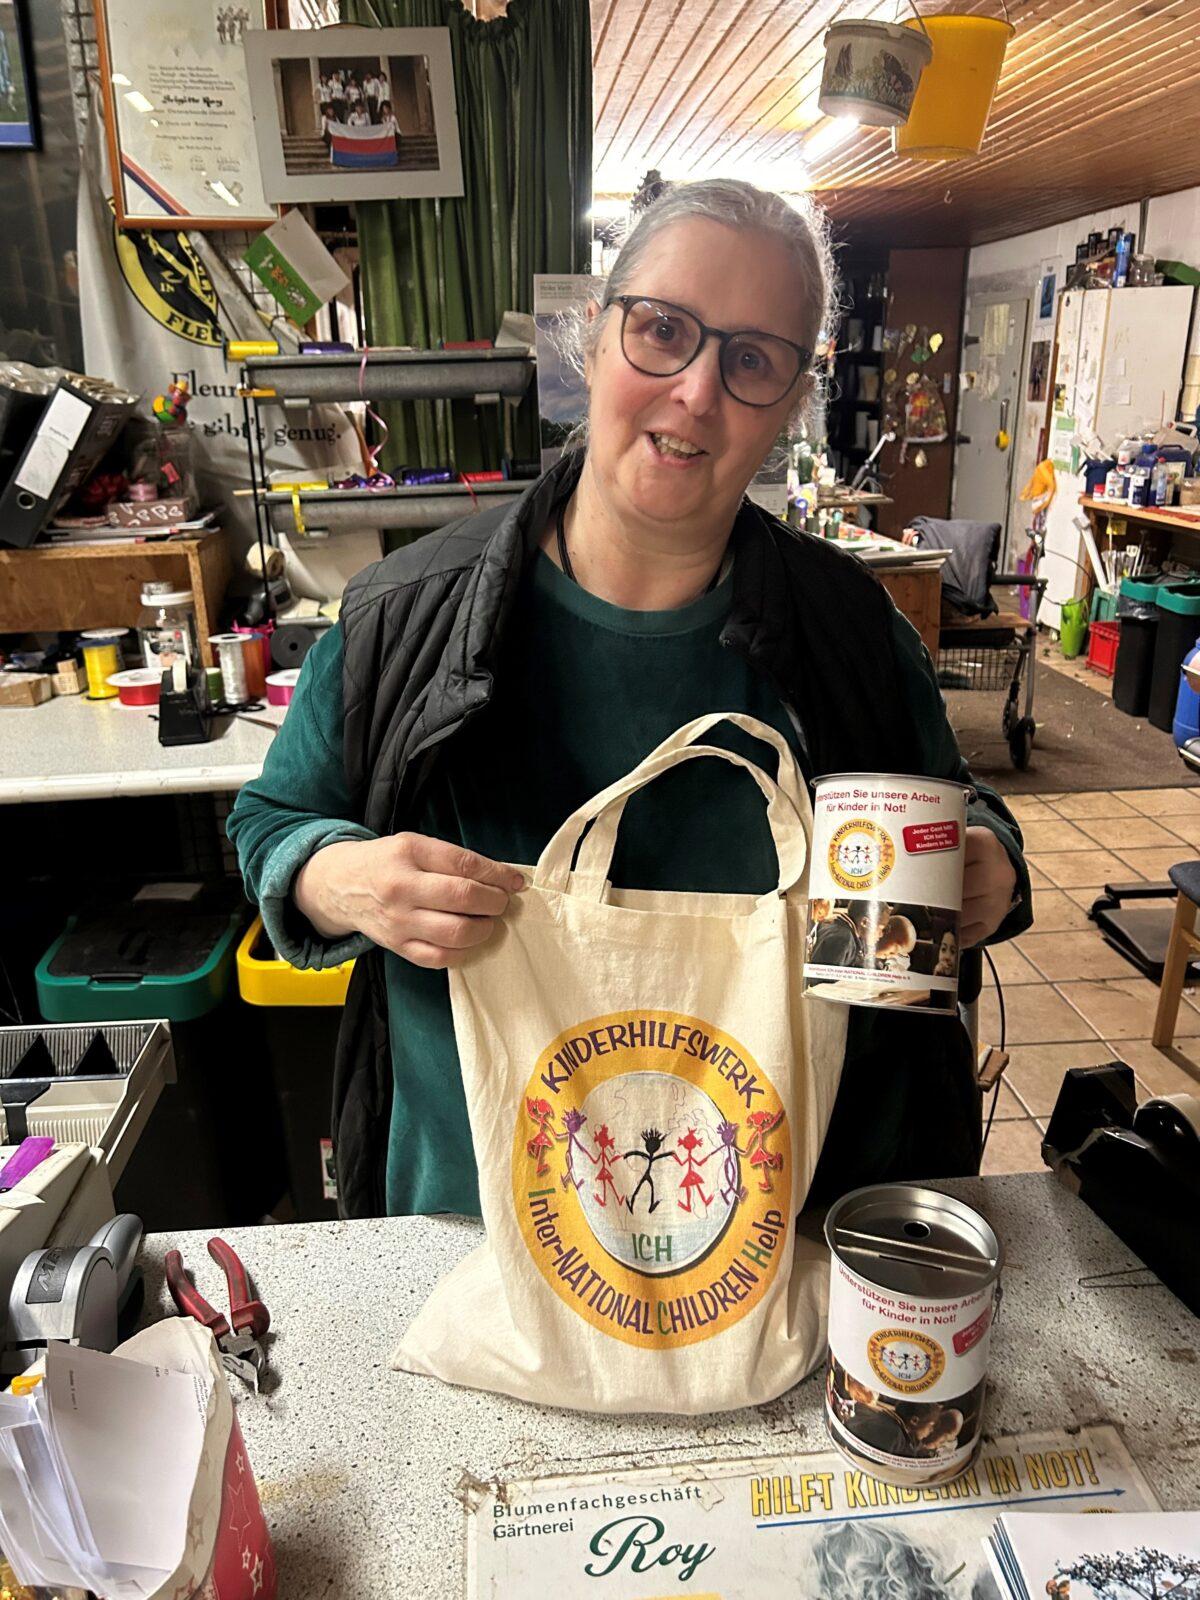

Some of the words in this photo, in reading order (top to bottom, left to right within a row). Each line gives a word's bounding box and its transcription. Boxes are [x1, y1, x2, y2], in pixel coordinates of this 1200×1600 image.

[274, 422, 341, 446] genug.
[827, 803, 836, 812] für
[838, 802, 868, 811] Kinder
[870, 802, 880, 811] in
[884, 803, 906, 813] Not!
[853, 789, 868, 798] Sie
[871, 791, 908, 800] unsere
[911, 792, 940, 804] Arbeit
[540, 1019, 765, 1109] KINDERHILFSWERK
[632, 1232, 673, 1263] ICH
[657, 1258, 760, 1336] CHILDREN
[741, 1208, 786, 1270] Help
[838, 1264, 896, 1308] Unterstützen
[899, 1301, 917, 1312] Sie
[920, 1303, 959, 1313] unsere
[862, 1298, 876, 1311] für
[879, 1306, 917, 1324] Kinder
[920, 1314, 930, 1324] in
[934, 1313, 957, 1324] Not!
[751, 1472, 834, 1516] HILFT
[983, 1456, 1022, 1495] IN
[1023, 1447, 1100, 1490] NOT!
[493, 1486, 702, 1519] Blumenfachgeschäft
[493, 1517, 575, 1541] Gärtnerei
[584, 1515, 717, 1581] Roy
